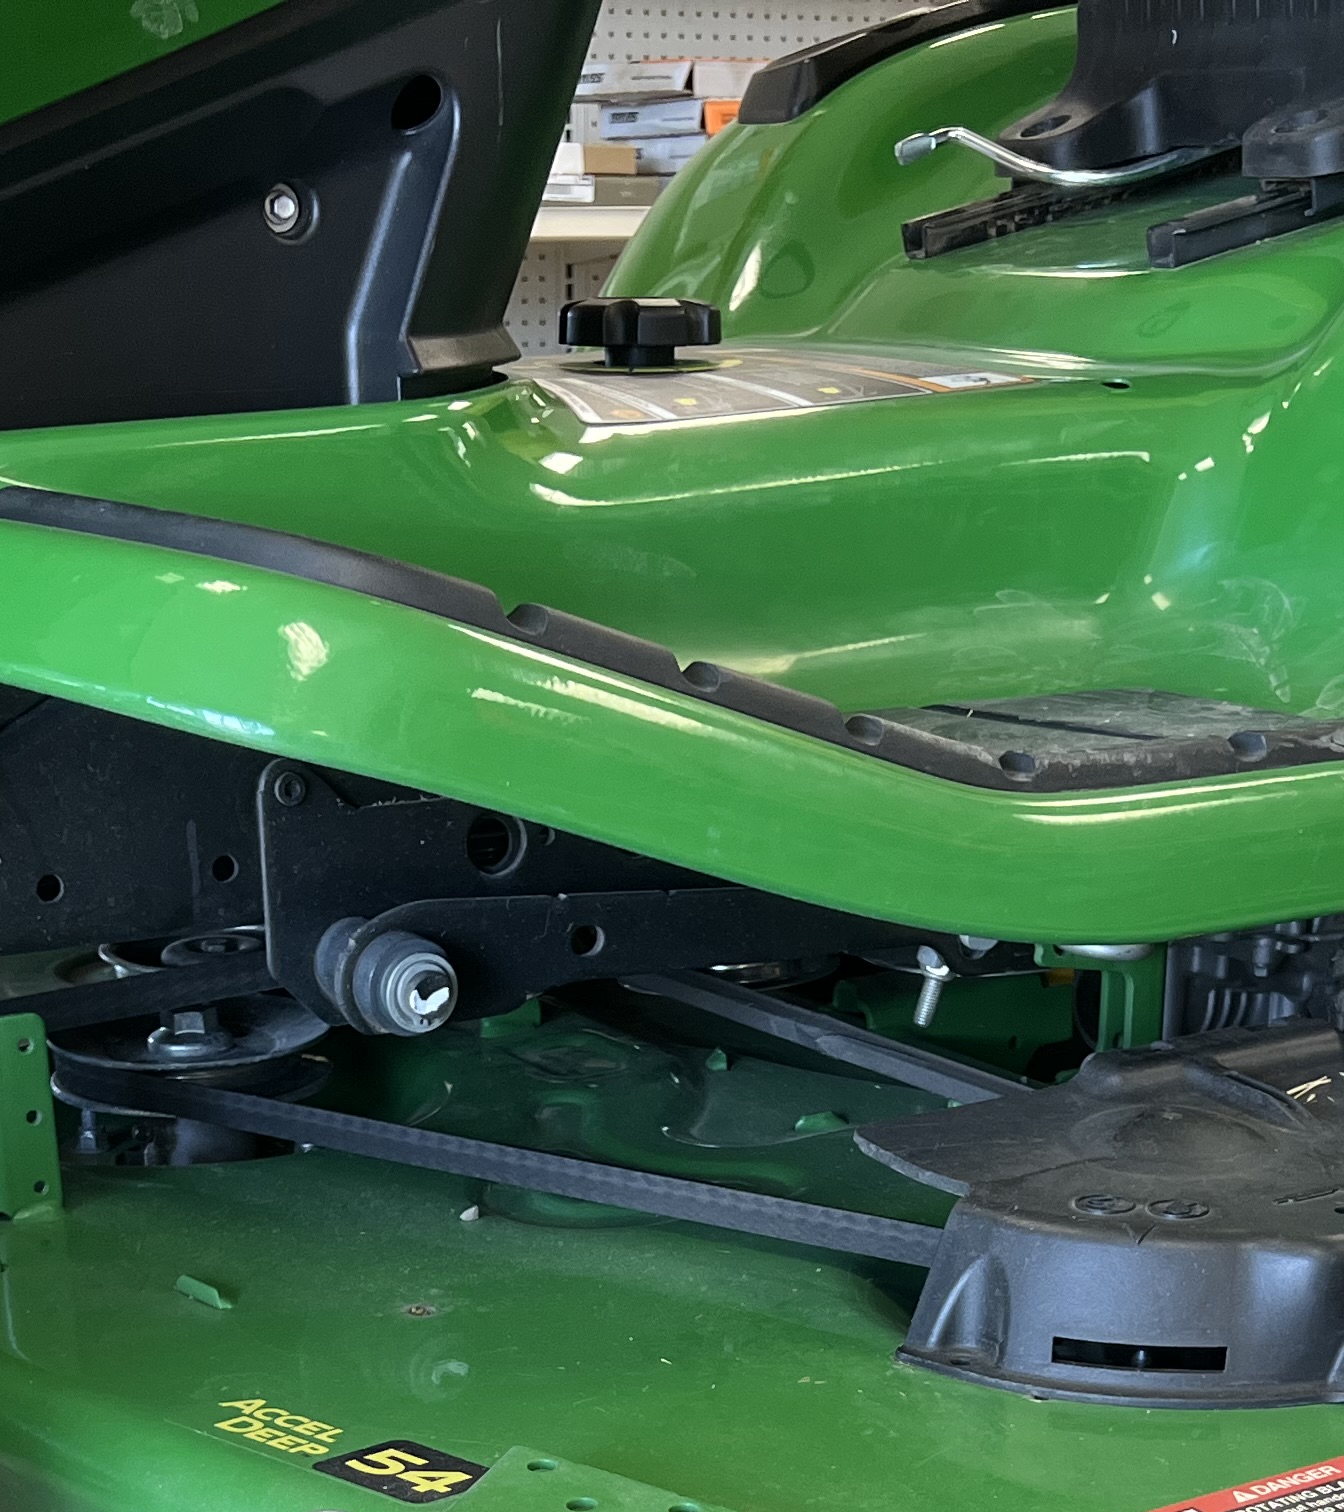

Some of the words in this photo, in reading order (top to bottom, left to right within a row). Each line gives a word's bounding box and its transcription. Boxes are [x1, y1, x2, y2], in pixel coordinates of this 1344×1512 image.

[214, 1415, 330, 1456] DEEP
[218, 1398, 344, 1443] ACCEL
[345, 1448, 473, 1494] 54
[1249, 1465, 1343, 1495] DANGER
